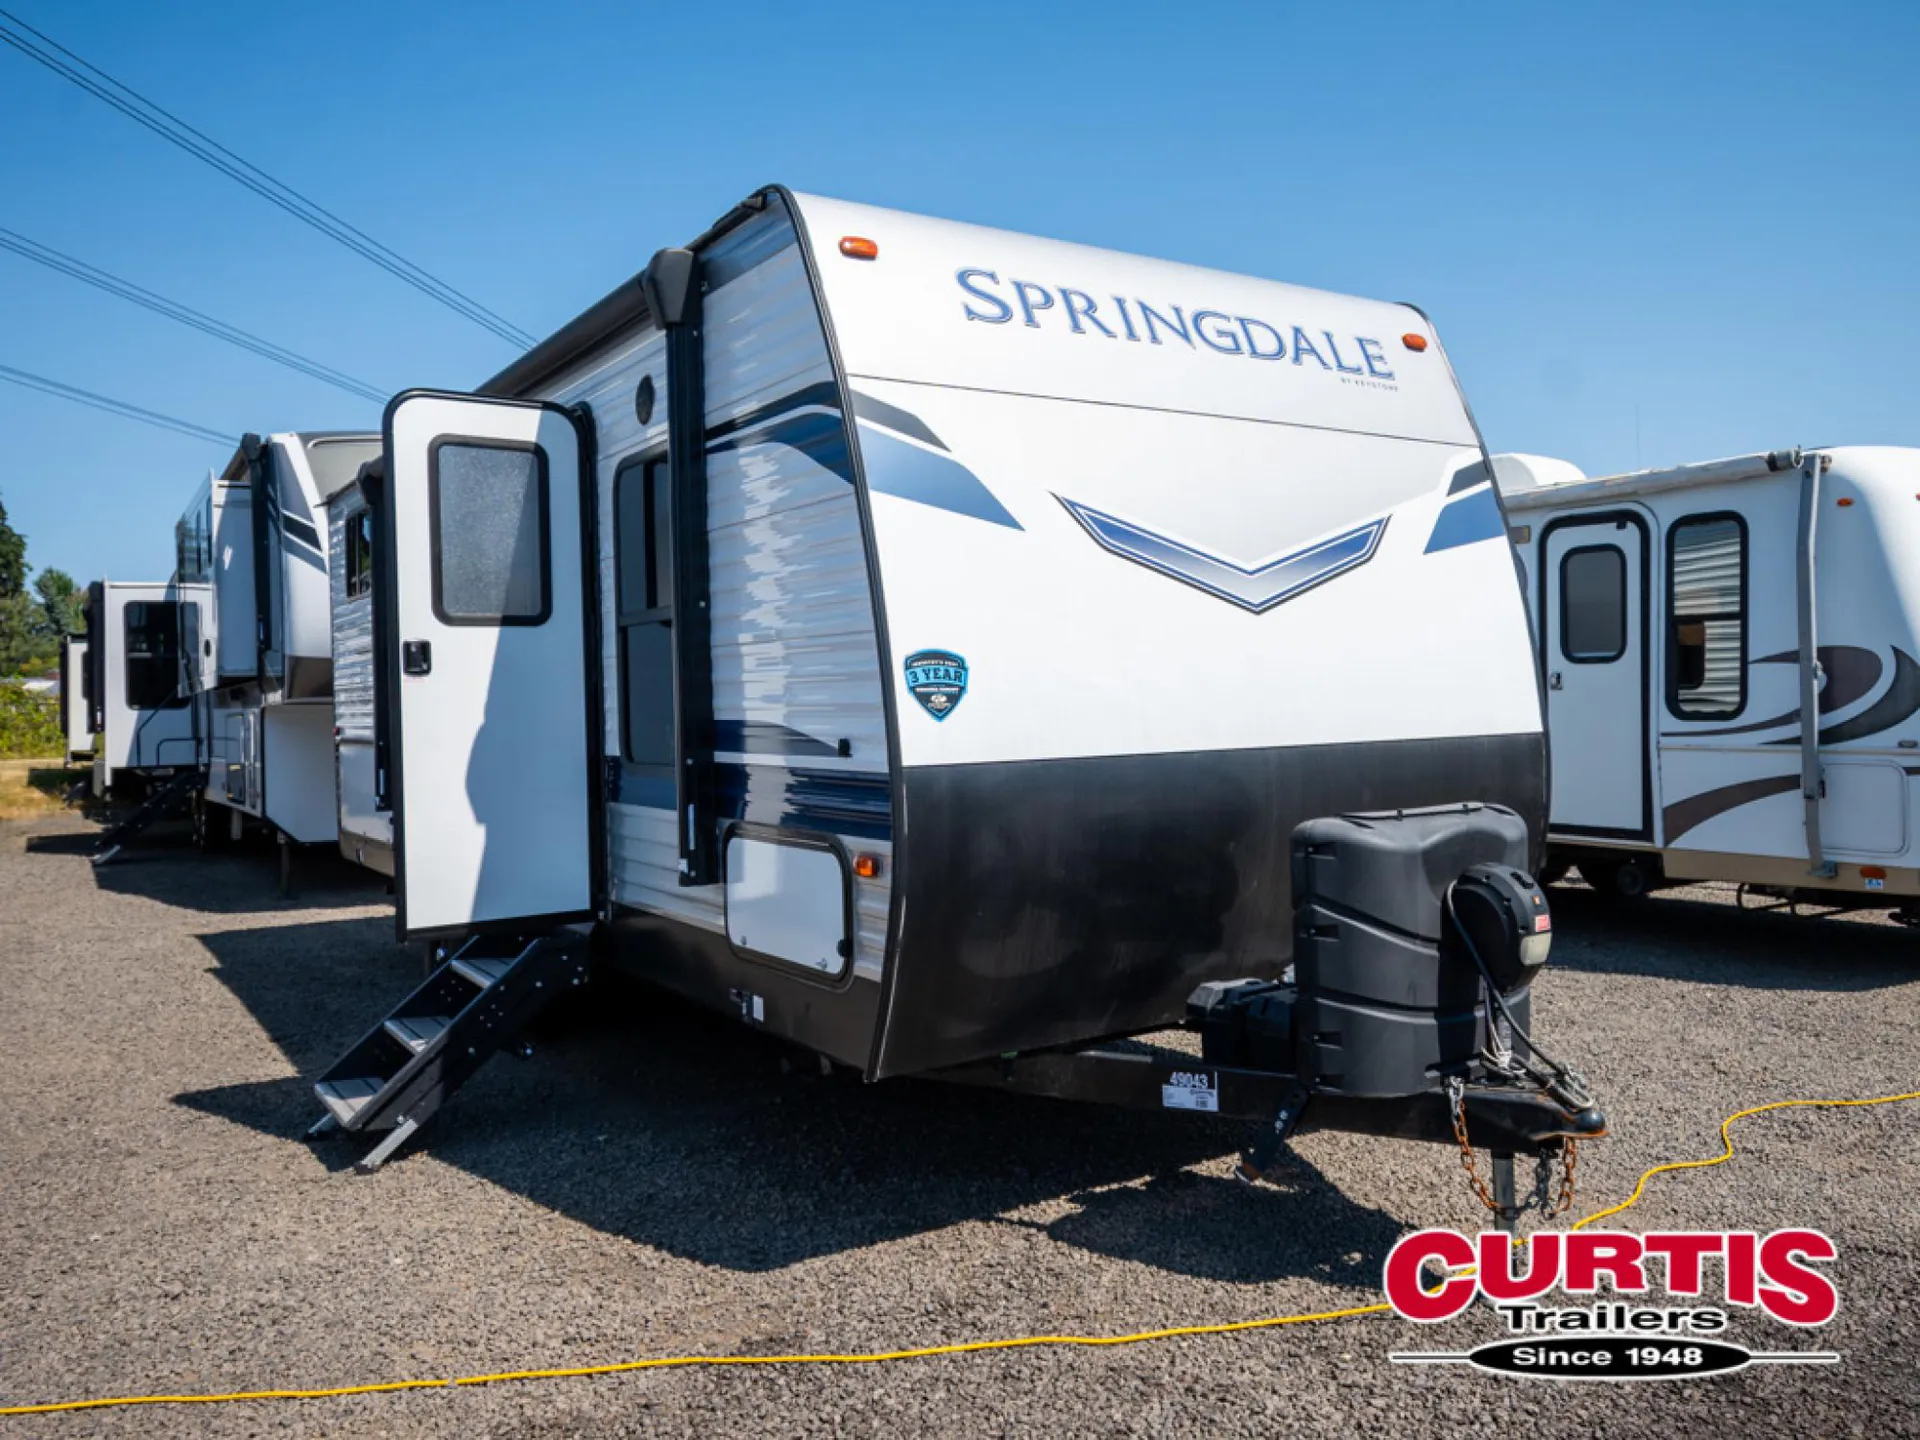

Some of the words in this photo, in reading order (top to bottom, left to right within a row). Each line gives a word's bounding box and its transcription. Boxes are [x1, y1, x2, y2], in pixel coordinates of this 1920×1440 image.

[956, 267, 1396, 381] SPRINGDALE
[908, 670, 919, 683] 3
[922, 667, 963, 683] YEAR
